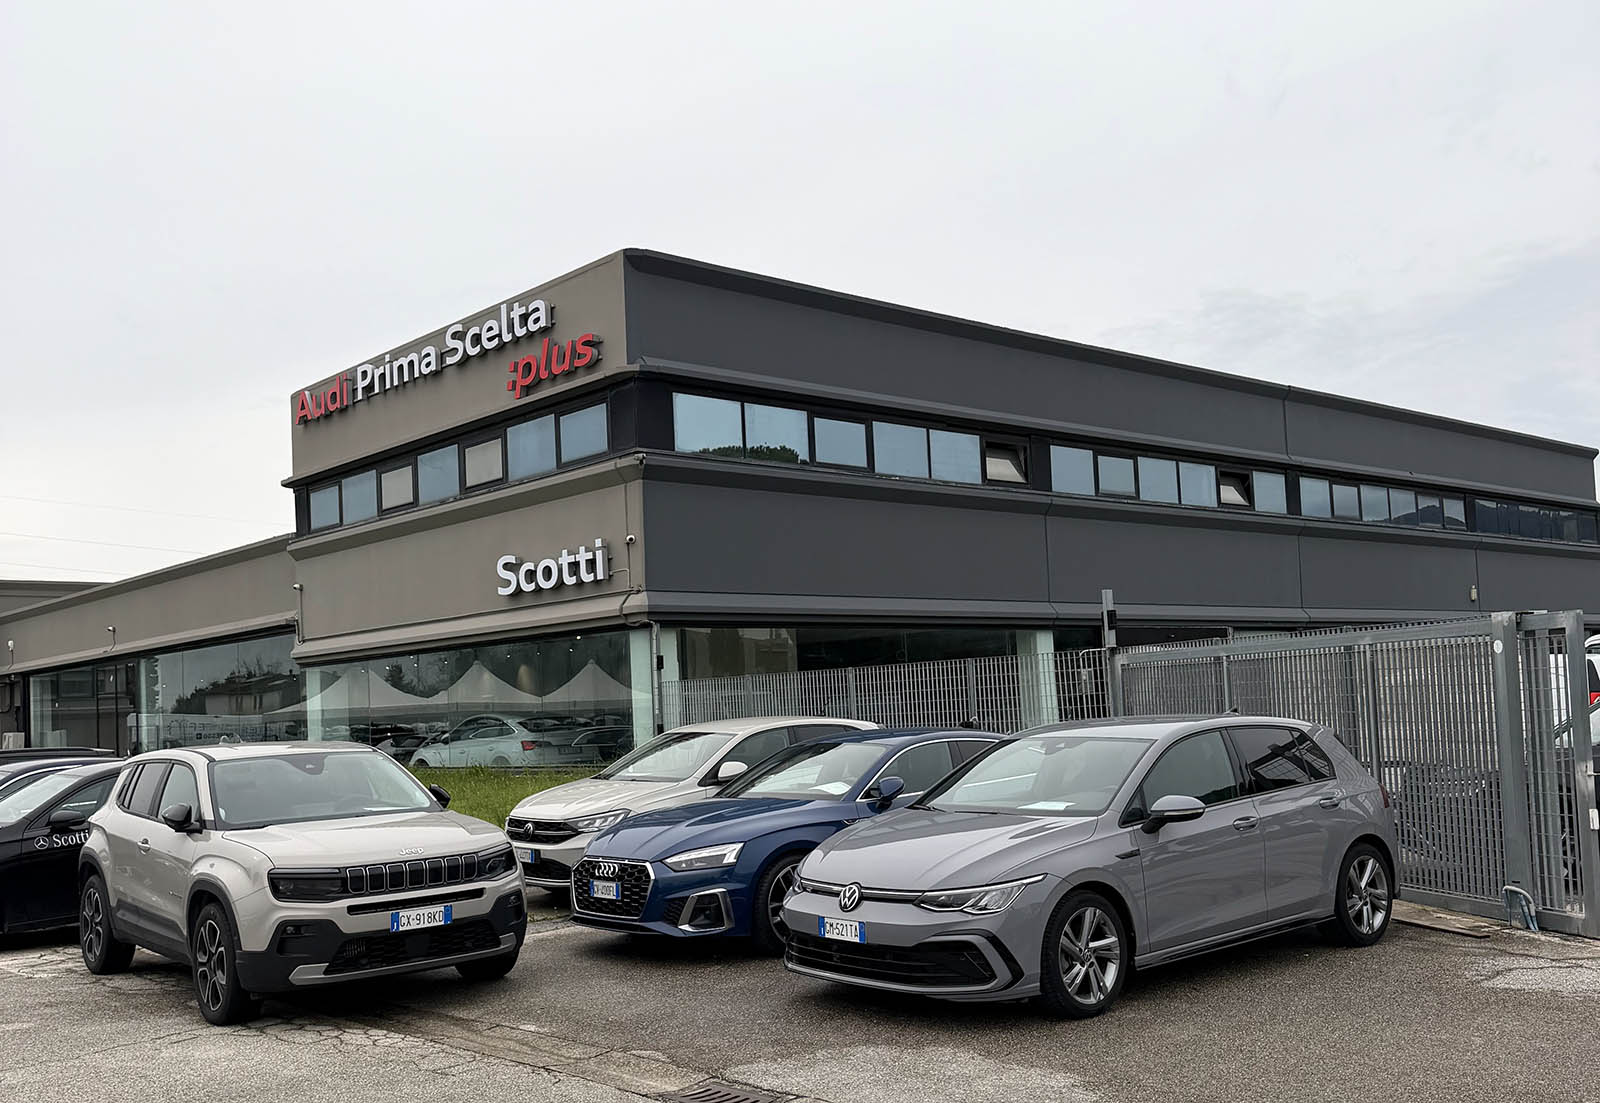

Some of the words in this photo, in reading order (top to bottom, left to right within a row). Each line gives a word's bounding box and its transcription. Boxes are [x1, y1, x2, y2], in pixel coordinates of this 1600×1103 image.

[295, 372, 349, 425] Audi
[356, 347, 438, 401] Prima
[445, 299, 549, 364] Scelta
[496, 538, 606, 595] Scotti
[53, 829, 90, 848] Scotti
[399, 847, 425, 856] Jeep
